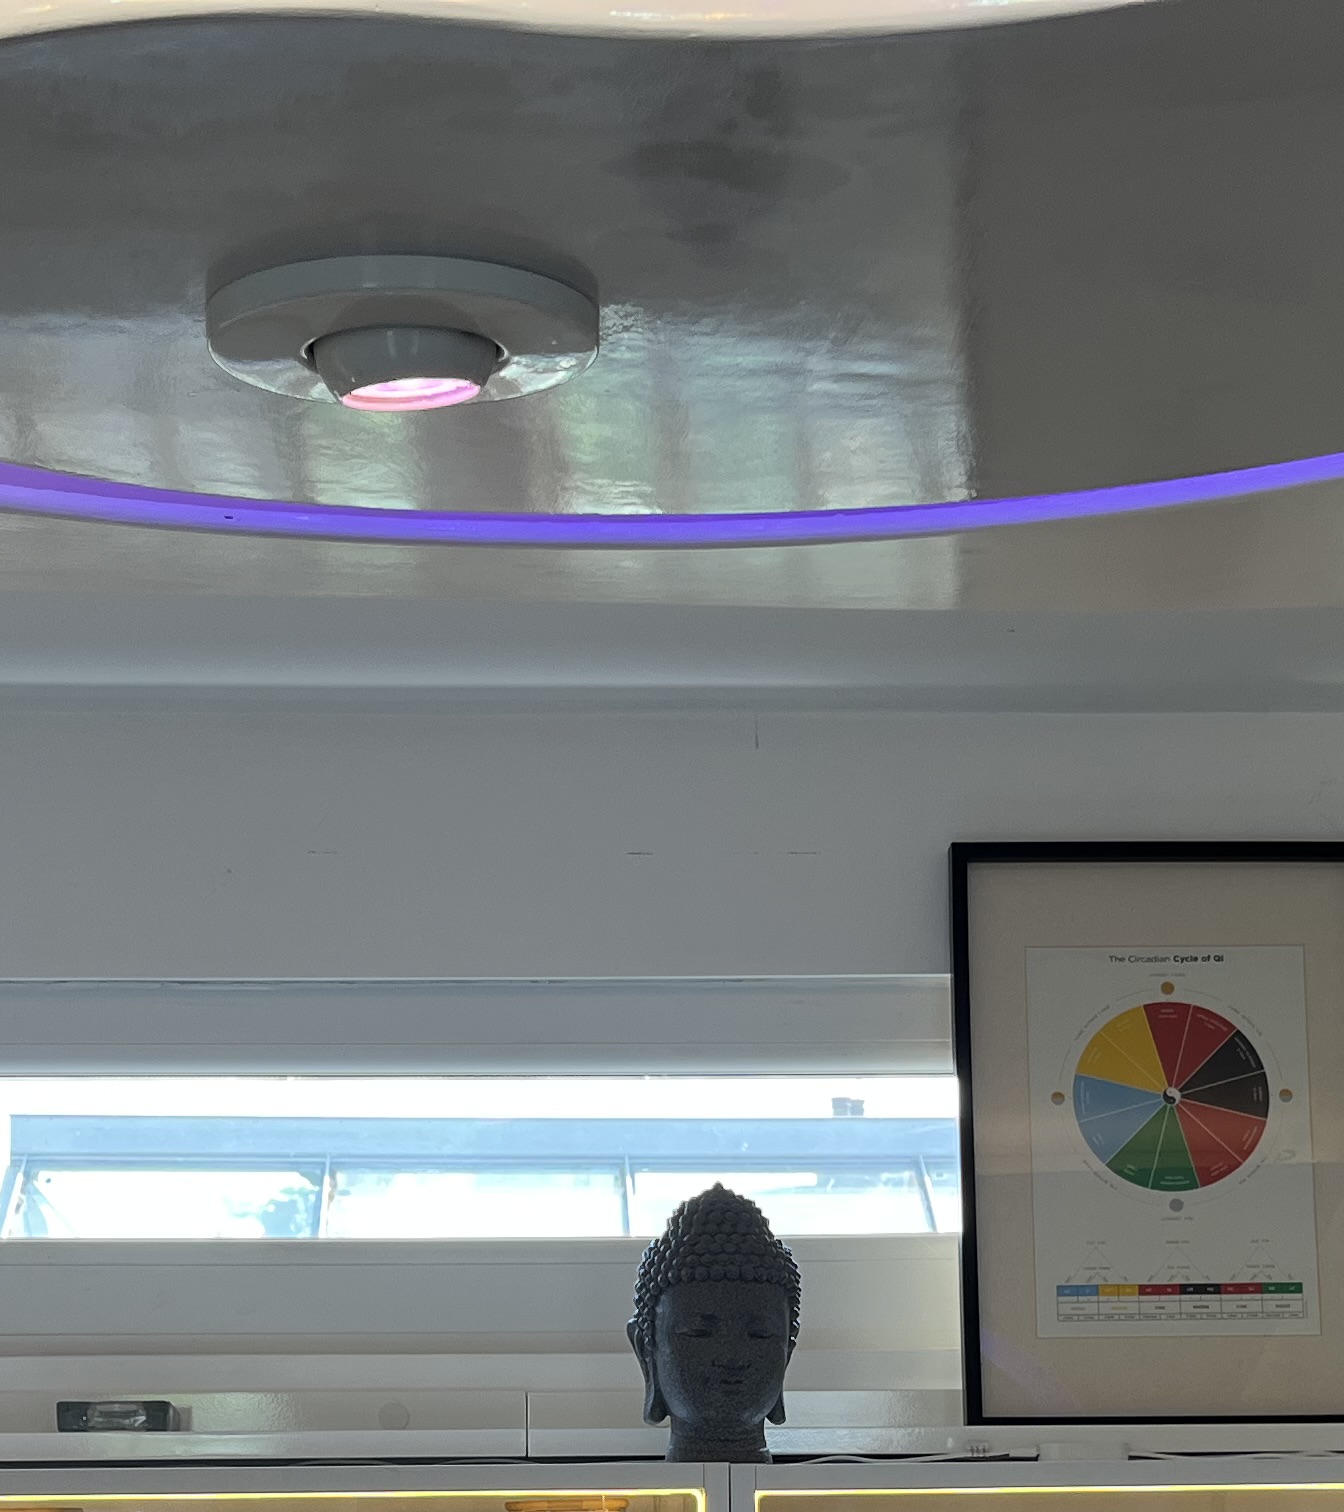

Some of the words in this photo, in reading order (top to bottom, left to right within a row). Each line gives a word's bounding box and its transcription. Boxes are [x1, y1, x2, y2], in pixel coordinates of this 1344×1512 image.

[1108, 954, 1126, 963] The
[1127, 954, 1171, 964] Circadian
[1172, 954, 1199, 964] Cycle
[1201, 954, 1211, 963] of
